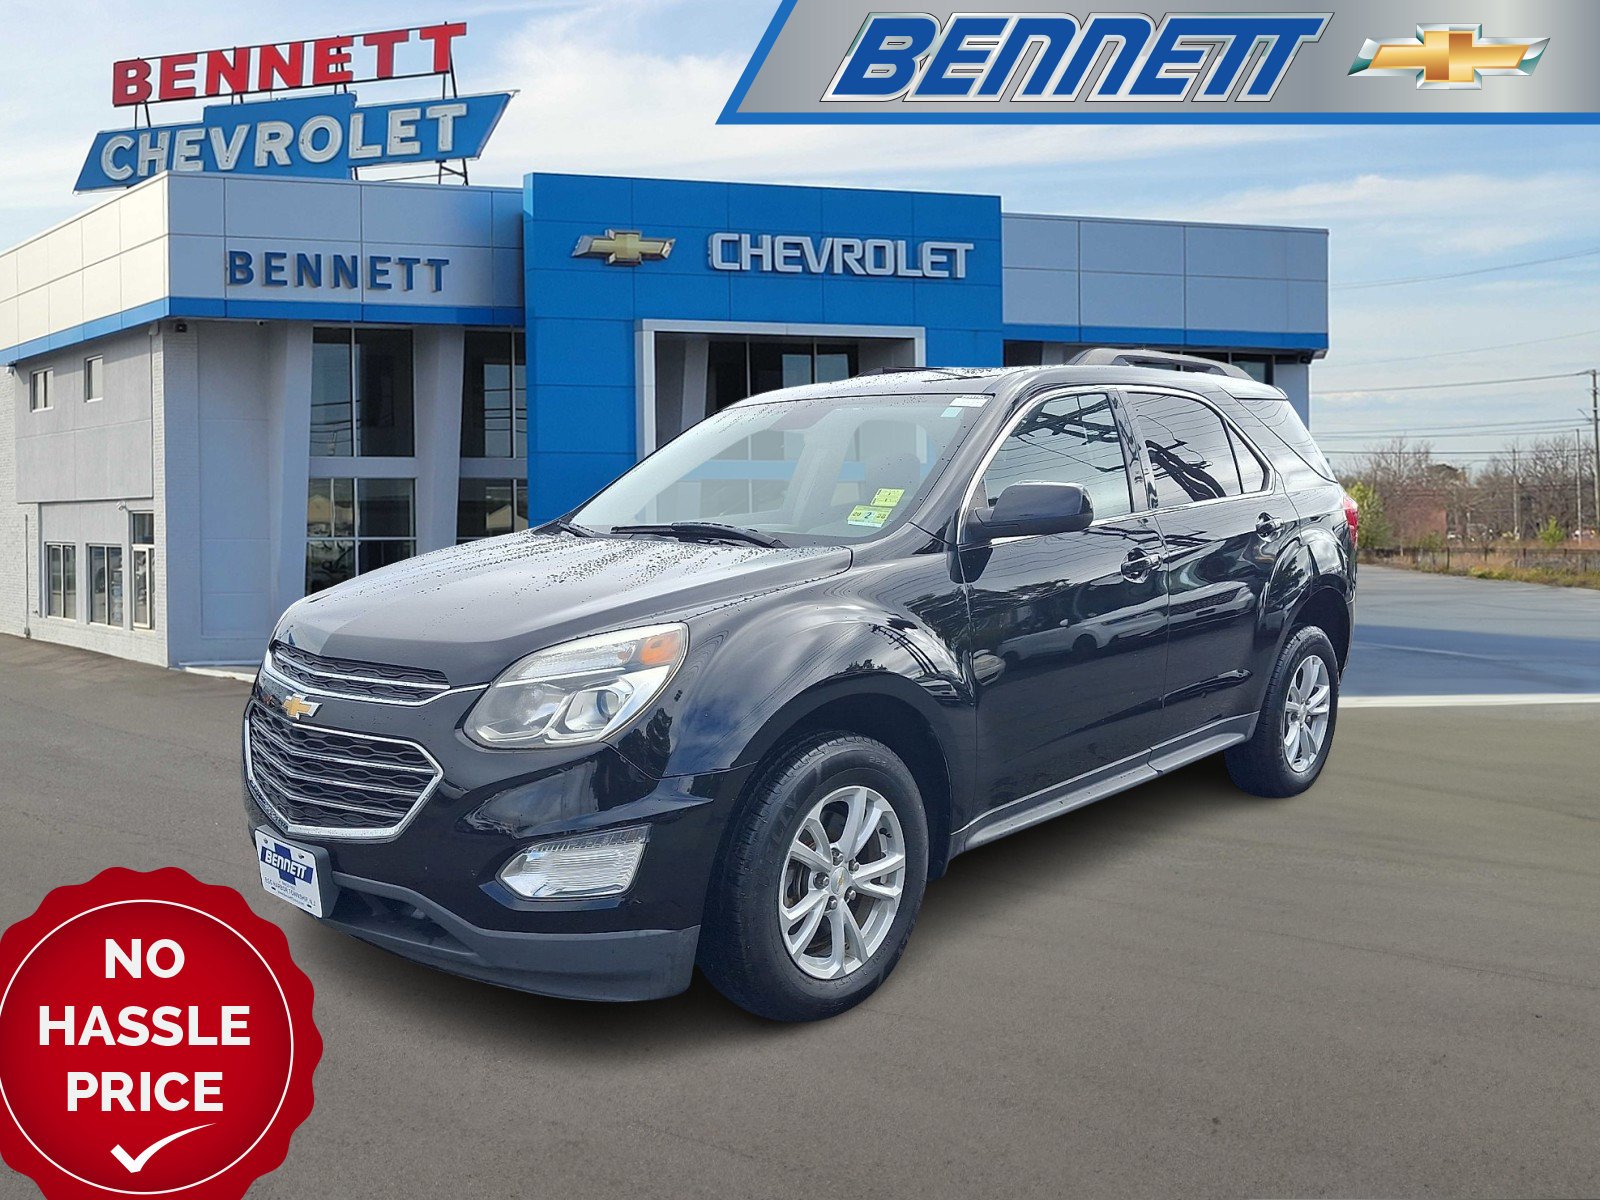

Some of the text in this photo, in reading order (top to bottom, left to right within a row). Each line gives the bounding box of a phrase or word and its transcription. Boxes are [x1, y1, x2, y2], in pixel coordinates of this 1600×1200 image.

[112, 22, 467, 106] BENNETT
[99, 102, 468, 182] CHEVROLET
[226, 249, 450, 293] BENNETT
[708, 232, 974, 279] CHEVROLET
[264, 849, 307, 880] BENNETT
